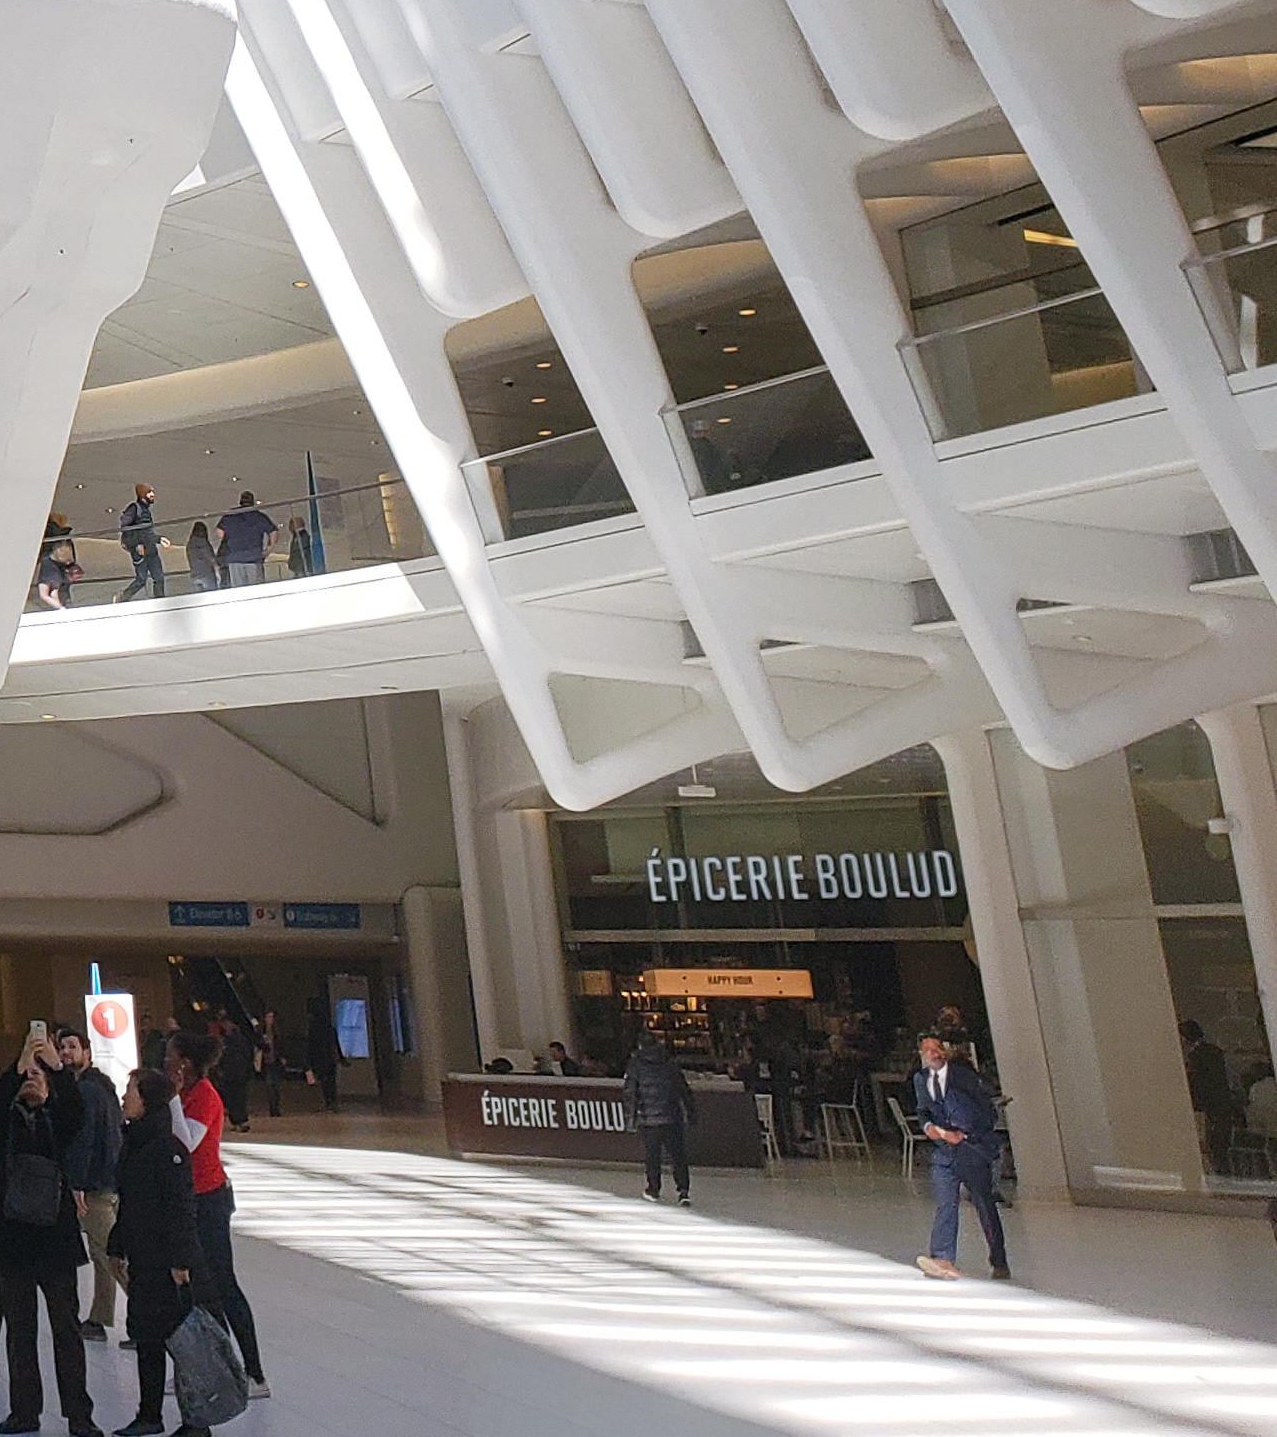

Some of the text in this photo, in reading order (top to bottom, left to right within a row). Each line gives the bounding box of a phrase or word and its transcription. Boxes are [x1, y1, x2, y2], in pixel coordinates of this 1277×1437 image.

[646, 847, 959, 903] ÉPICERIE BOULUD
[707, 975, 753, 985] HAPPY HOUR
[102, 1007, 116, 1032] 1
[480, 1089, 625, 1132] ÉPICERIE BOULU
